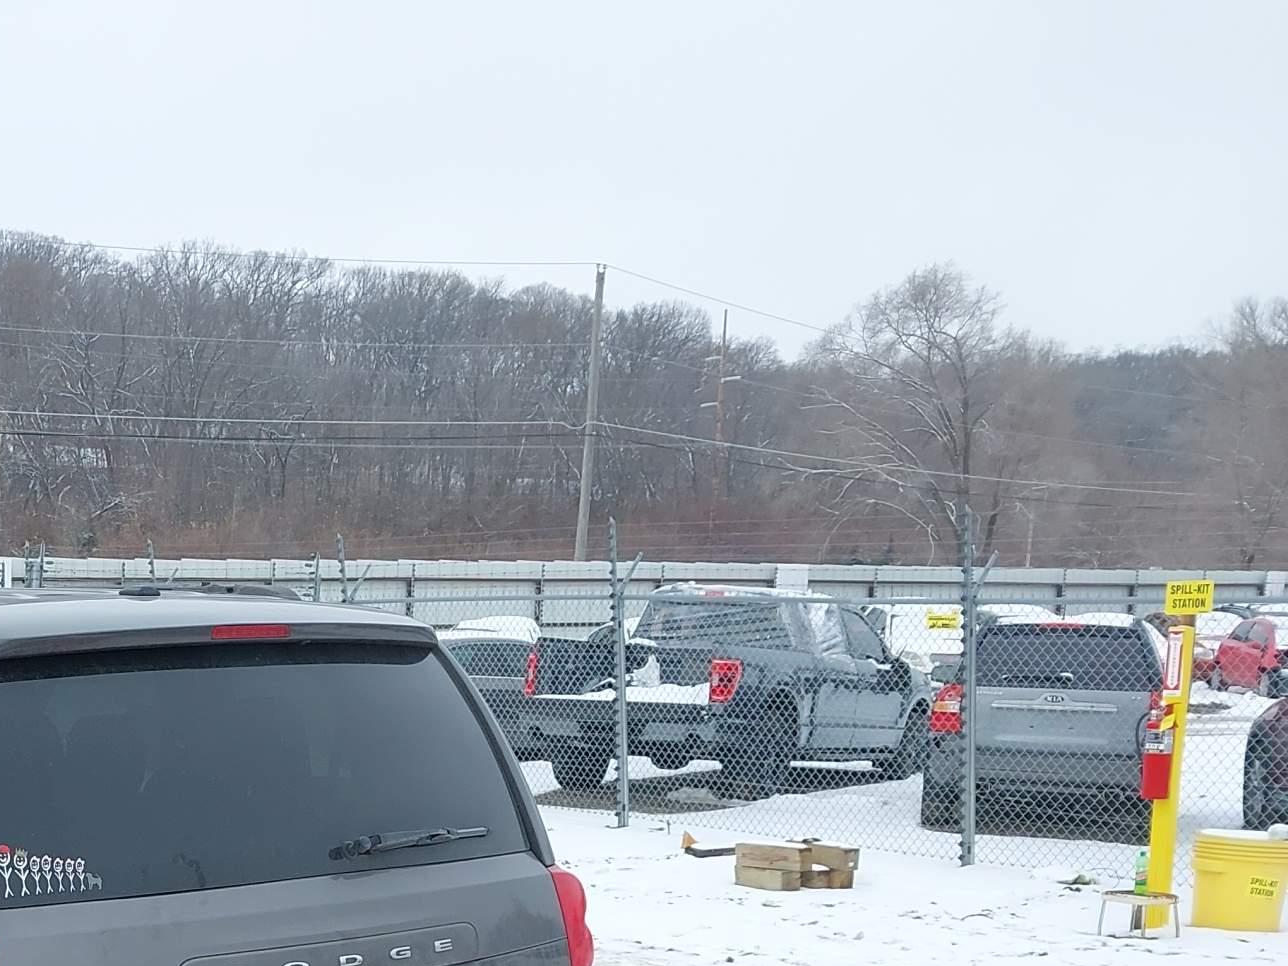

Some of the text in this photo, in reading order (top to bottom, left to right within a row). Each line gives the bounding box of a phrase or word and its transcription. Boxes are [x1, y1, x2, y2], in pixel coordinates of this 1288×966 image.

[1170, 584, 1210, 594] SPILL-KIT
[1172, 598, 1206, 608] STATION
[1045, 695, 1064, 703] KIA
[1250, 887, 1274, 896] STATION
